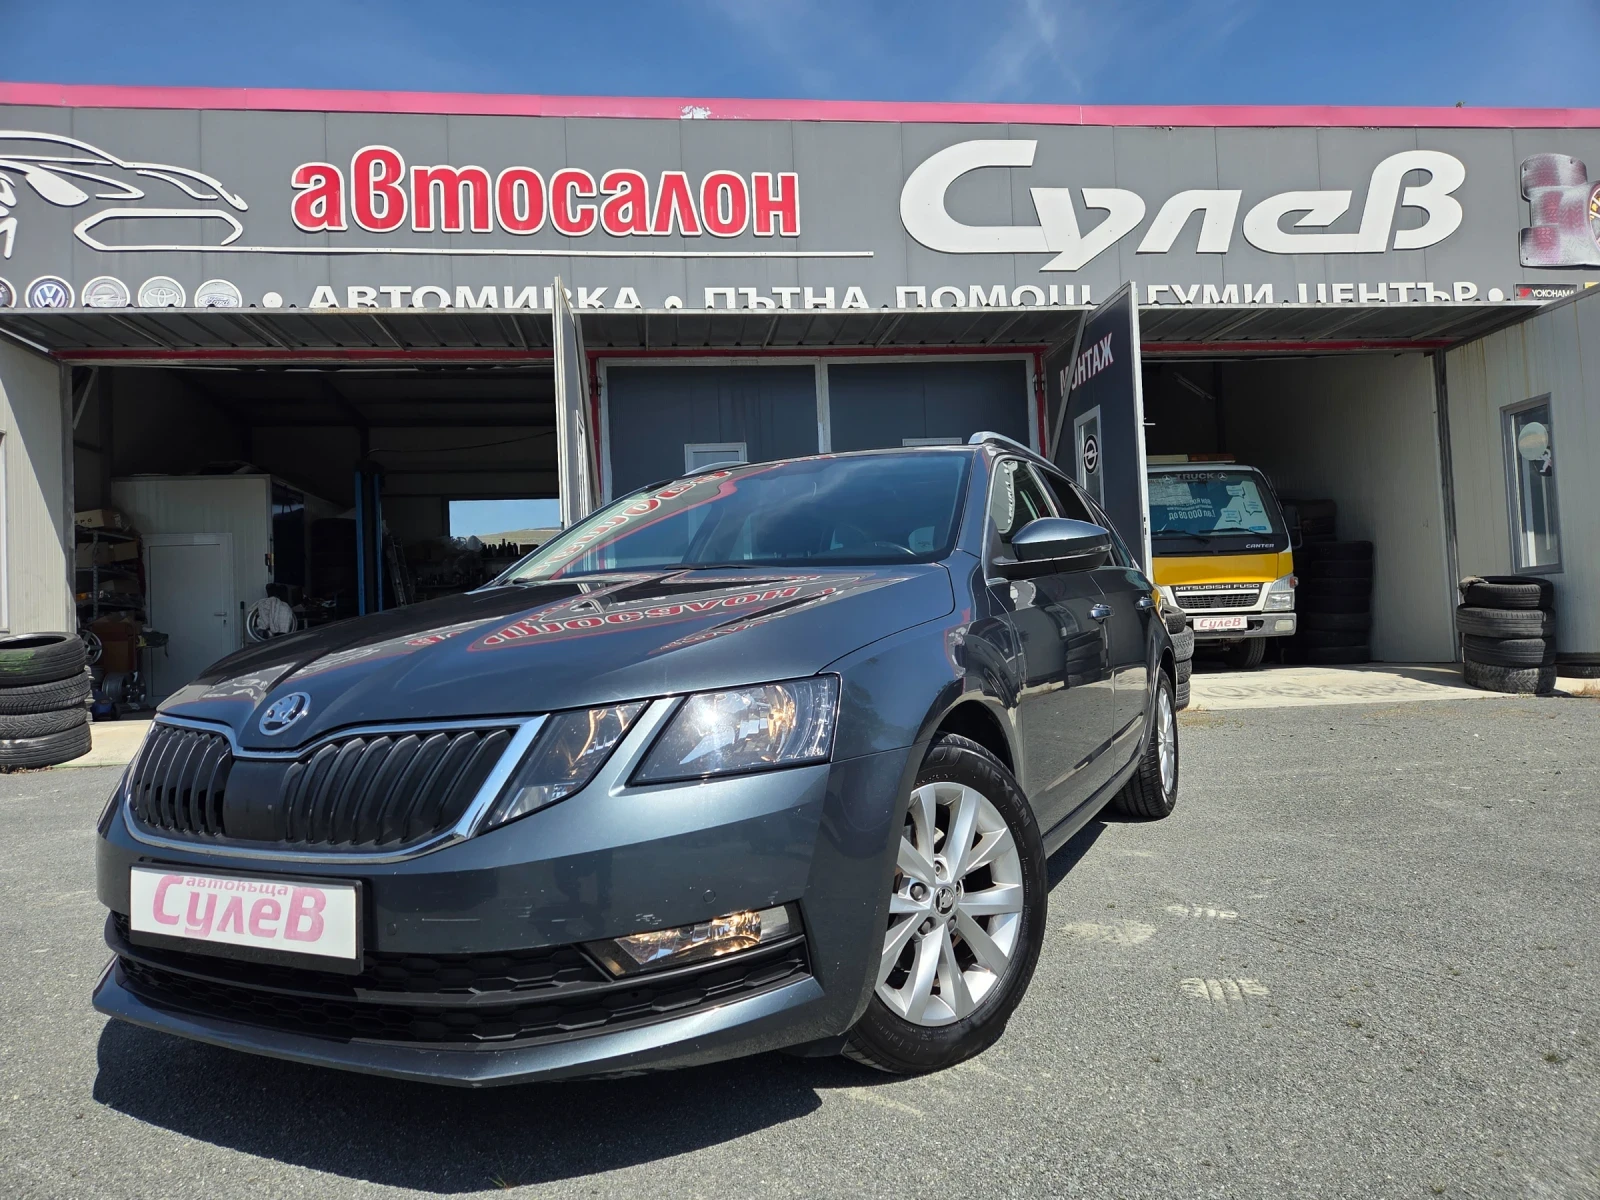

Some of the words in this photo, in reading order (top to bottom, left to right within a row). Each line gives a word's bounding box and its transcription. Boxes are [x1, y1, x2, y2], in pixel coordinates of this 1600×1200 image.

[291, 144, 800, 237] автосалон
[1176, 583, 1231, 591] MITSUBISHI
[185, 876, 289, 897] автокъща
